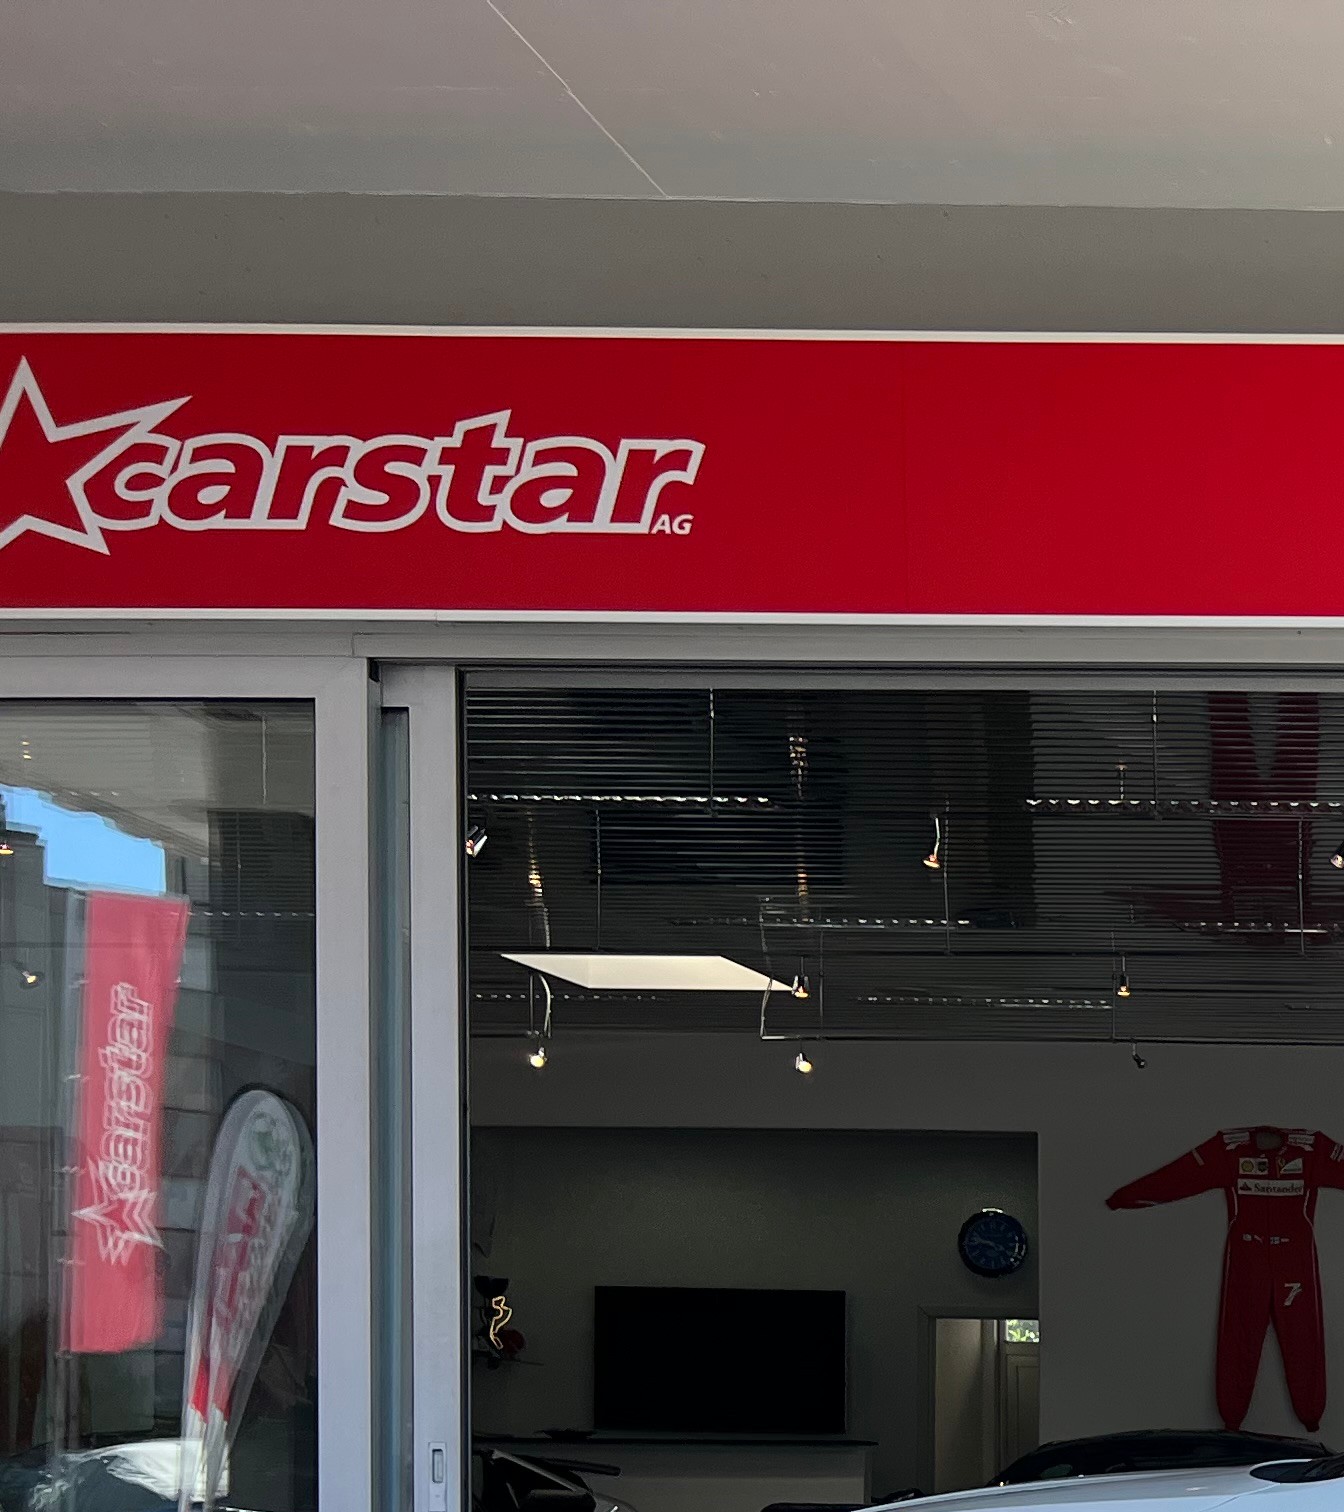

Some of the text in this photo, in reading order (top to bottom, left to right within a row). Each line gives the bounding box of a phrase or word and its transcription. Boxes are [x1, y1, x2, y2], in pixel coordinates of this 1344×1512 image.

[84, 409, 706, 536] carstar AG
[1284, 1283, 1302, 1306] 7
